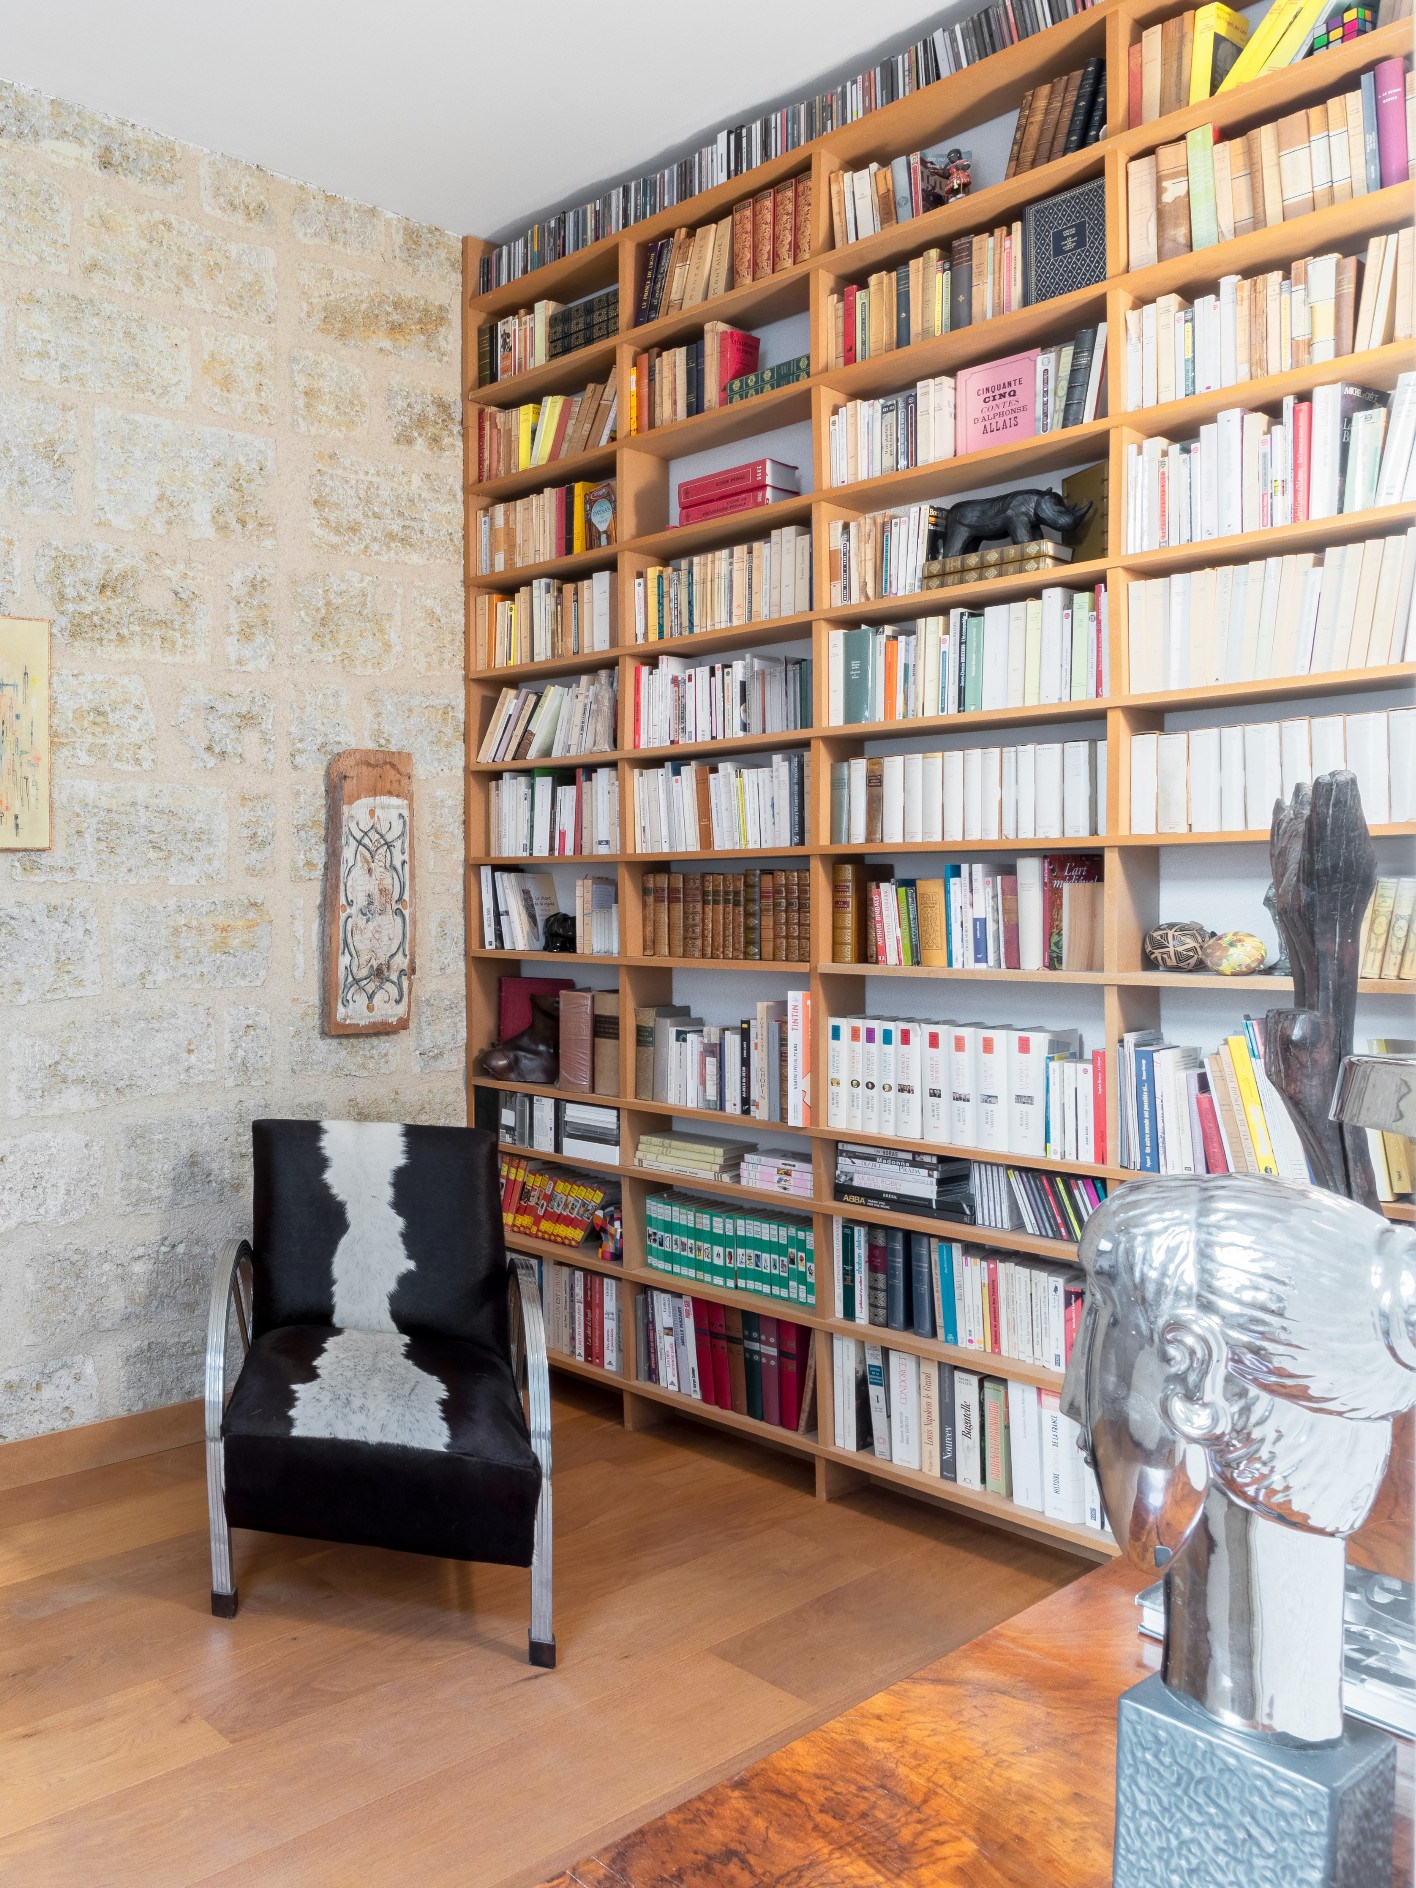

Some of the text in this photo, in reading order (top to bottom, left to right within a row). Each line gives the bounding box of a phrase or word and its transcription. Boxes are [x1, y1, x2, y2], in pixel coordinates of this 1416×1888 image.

[689, 244, 703, 300] MONTAIGNE
[712, 242, 723, 296] MONTAIGNE
[977, 377, 1023, 396] CINQUANTE
[983, 389, 1017, 404] CINQ
[973, 405, 1028, 424] D'ALPHONSE
[981, 399, 1020, 414] CONTES
[982, 416, 1019, 435] ALLAIS
[716, 479, 729, 487] CODE
[1064, 863, 1087, 875] L'art
[873, 895, 881, 921] RIMBAUD
[876, 1157, 910, 1167] Madonna
[843, 1195, 865, 1204] ABBA
[961, 1401, 972, 1440] Bagatelle
[942, 1425, 953, 1461] Noureev
[1052, 1472, 1061, 1495] HISTOIRE
